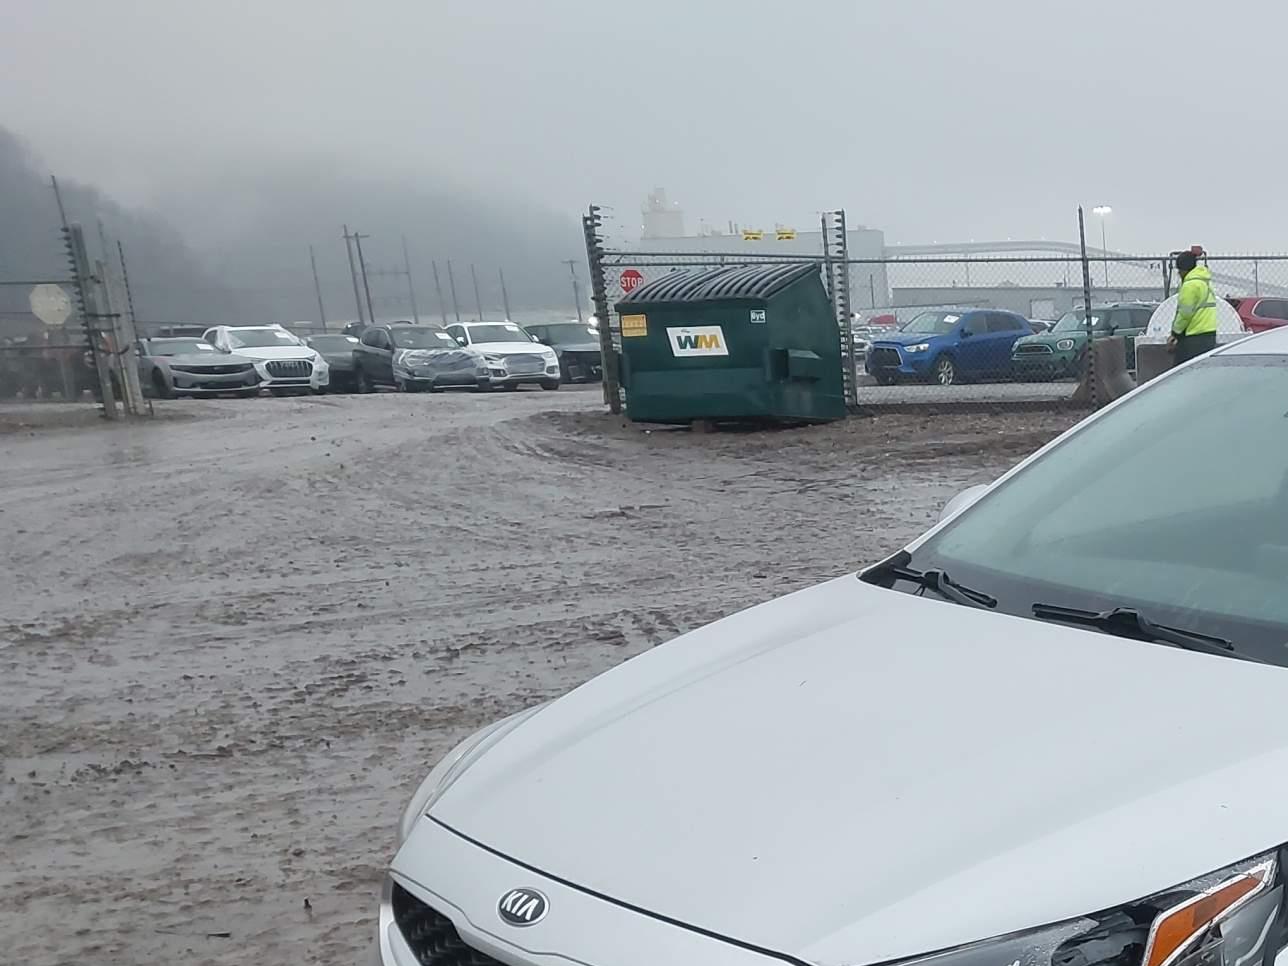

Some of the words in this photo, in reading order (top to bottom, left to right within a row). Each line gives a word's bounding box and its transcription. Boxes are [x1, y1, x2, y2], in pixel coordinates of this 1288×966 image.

[620, 276, 644, 288] STOP
[676, 334, 721, 350] WM
[501, 890, 540, 921] KIA
